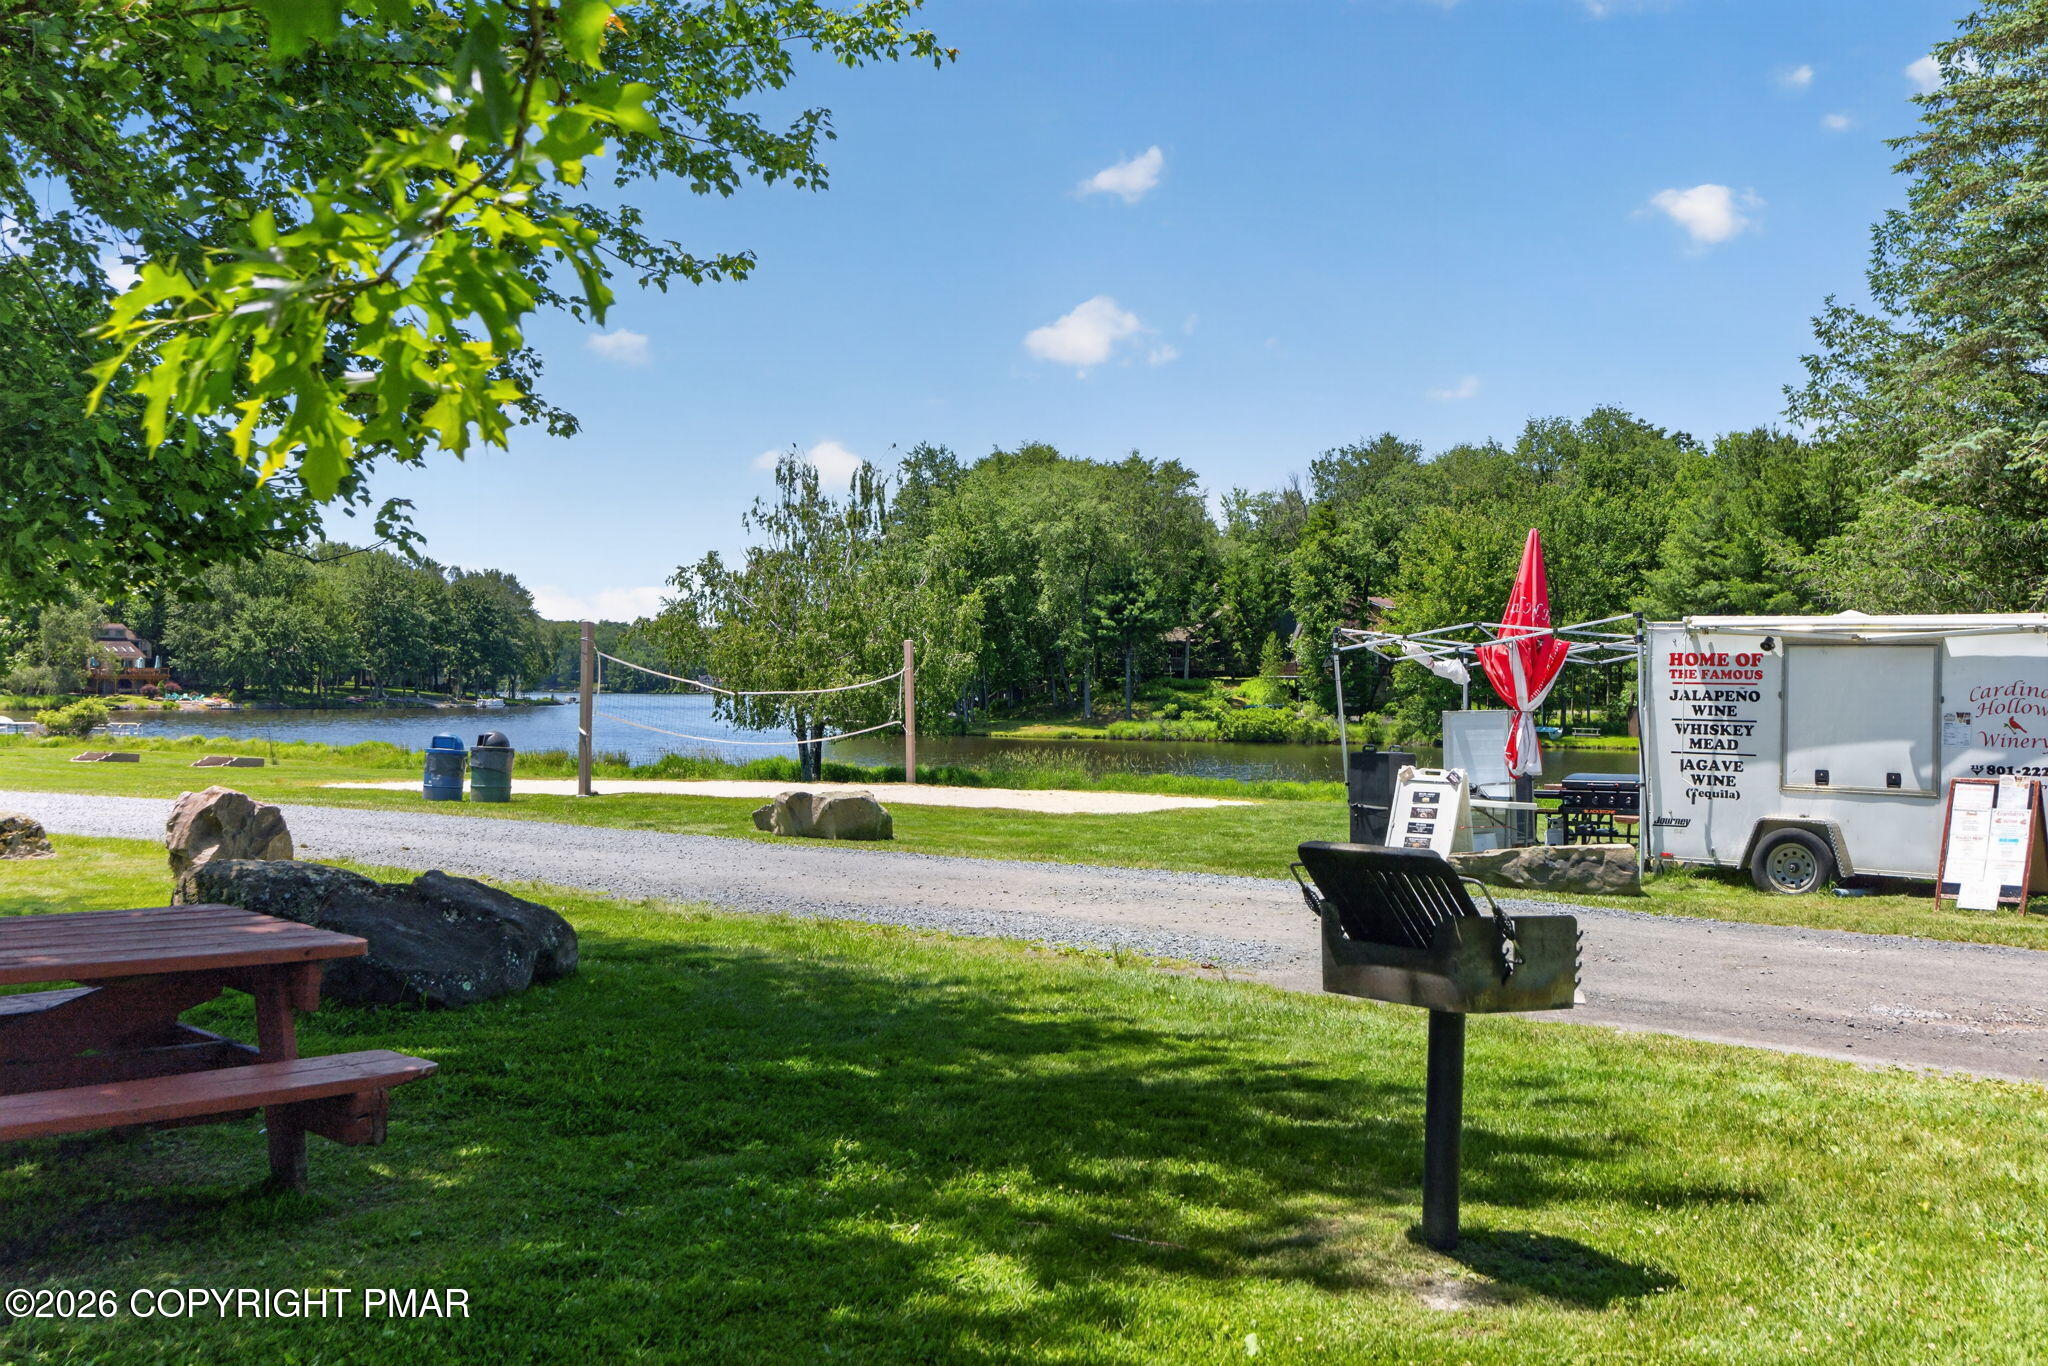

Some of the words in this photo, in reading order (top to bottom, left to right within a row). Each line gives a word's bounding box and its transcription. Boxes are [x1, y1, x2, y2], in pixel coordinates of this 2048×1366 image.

[1669, 653, 1729, 667] HOME
[1735, 653, 1764, 667] OF
[1669, 669, 1698, 679] THE
[1701, 669, 1763, 680] FAMOUS
[1692, 704, 1737, 717] WINE
[1674, 723, 1755, 736] WHISKEY
[1689, 738, 1739, 750] MEAD
[1683, 759, 1744, 772] AGAVE
[1690, 774, 1737, 787] WINE
[1653, 815, 1691, 827] Journey
